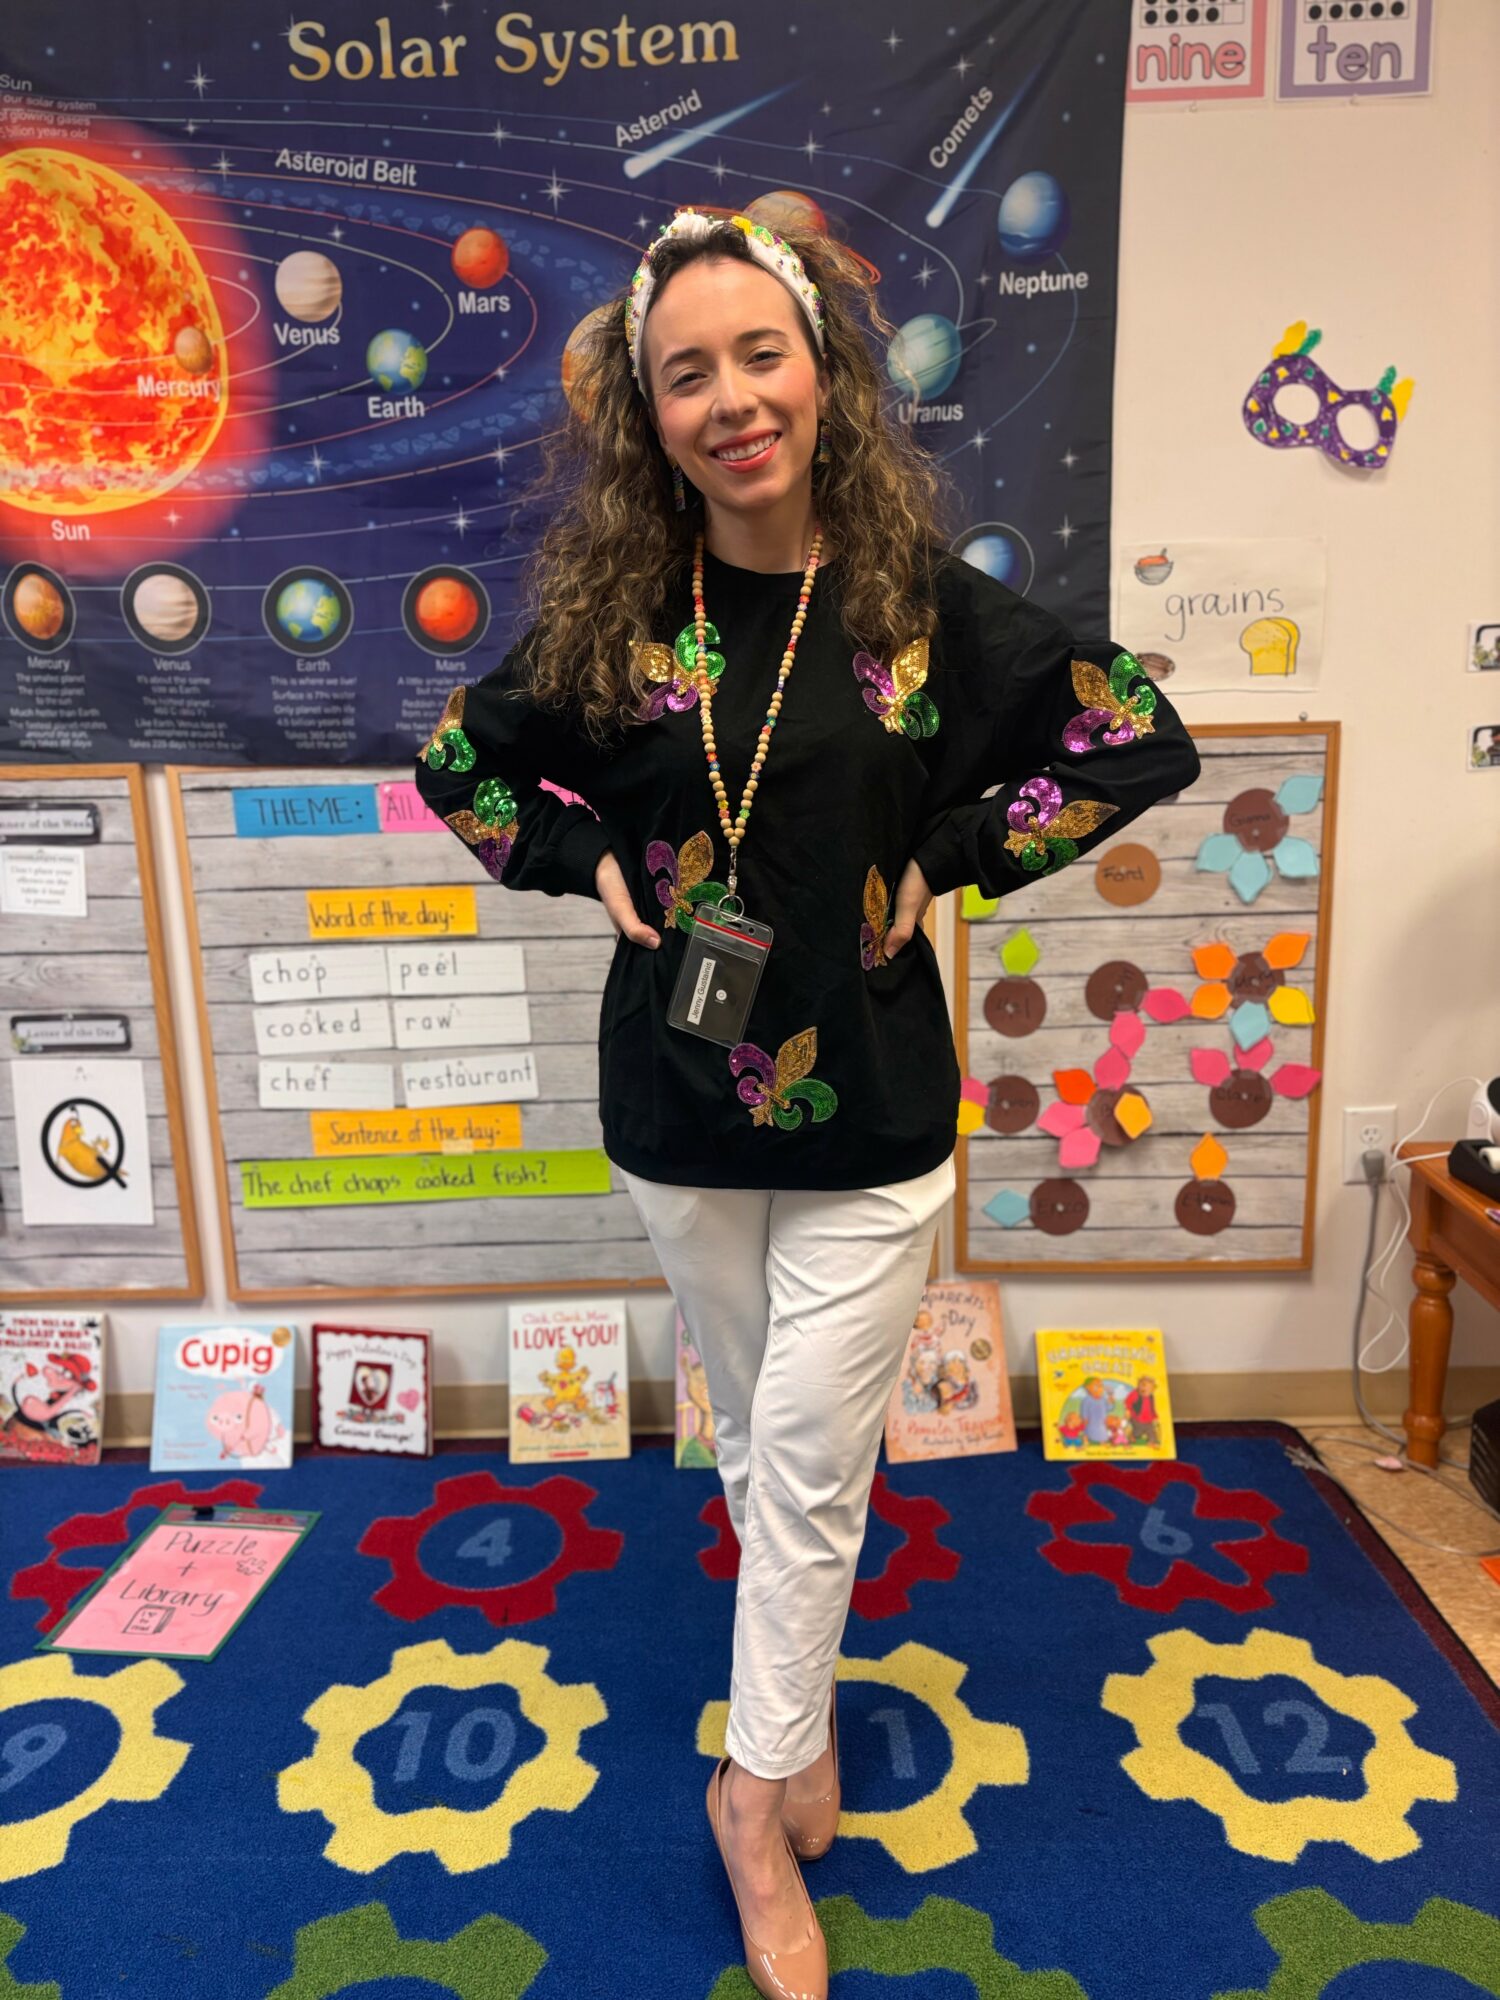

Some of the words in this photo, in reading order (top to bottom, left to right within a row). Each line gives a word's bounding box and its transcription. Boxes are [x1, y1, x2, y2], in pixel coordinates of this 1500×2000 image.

[287, 17, 467, 82] Solar
[495, 13, 740, 87] System
[1136, 33, 1247, 83] nine
[1307, 25, 1402, 82] ten
[0, 73, 33, 92] Sun
[57, 101, 97, 112] system
[613, 90, 703, 147] Asteroid
[70, 128, 89, 139] old
[928, 84, 994, 170] Comets
[275, 148, 368, 182] Asteroid
[373, 157, 417, 187] Belt
[999, 268, 1089, 299] Neptune
[458, 291, 511, 314] Mars
[273, 323, 340, 347] Venus
[137, 374, 221, 403] Mercury
[367, 395, 426, 418] Earth
[898, 401, 964, 426] Uranus
[51, 519, 91, 542] Sun
[1164, 580, 1284, 643] grains
[27, 656, 71, 673] Mercury
[153, 657, 192, 672] Venus
[296, 658, 331, 672] Earth
[435, 659, 467, 672] Mars
[251, 796, 364, 827] THEME:
[386, 795, 413, 822] All
[1102, 866, 1145, 882] Ford
[309, 901, 356, 929] Word
[360, 902, 375, 926] of
[383, 899, 411, 926] the
[416, 900, 456, 932] day:
[262, 959, 328, 994] chop
[401, 951, 458, 992] peel
[266, 1008, 362, 1038] cooked
[405, 1012, 453, 1031] raw
[691, 997, 704, 1019] Jenny
[27, 1027, 60, 1039] Letter
[62, 1027, 74, 1038] of
[76, 1027, 93, 1038] the
[97, 1028, 117, 1040] Day
[270, 1067, 332, 1093] chef
[406, 1057, 532, 1092] restaurant
[41, 1097, 128, 1190] Q
[329, 1121, 402, 1147] Sentence
[408, 1119, 422, 1143] of
[430, 1118, 460, 1142] the
[463, 1117, 501, 1147] day:
[242, 1170, 283, 1197] The
[289, 1173, 333, 1195] chef
[343, 1173, 401, 1194] chops
[415, 1167, 476, 1191] cooked
[492, 1160, 549, 1186] fish?
[513, 1329, 519, 1349] I
[523, 1325, 567, 1350] LOVE
[572, 1322, 619, 1348] YOU!
[181, 1338, 274, 1375] Cupig
[164, 1531, 259, 1558] Puzzle
[456, 1518, 513, 1567] 4
[1138, 1505, 1194, 1556] 6
[119, 1579, 225, 1617] Library
[392, 1707, 518, 1783] 10
[1196, 1699, 1354, 1776] 12
[0, 1722, 68, 1795] 9
